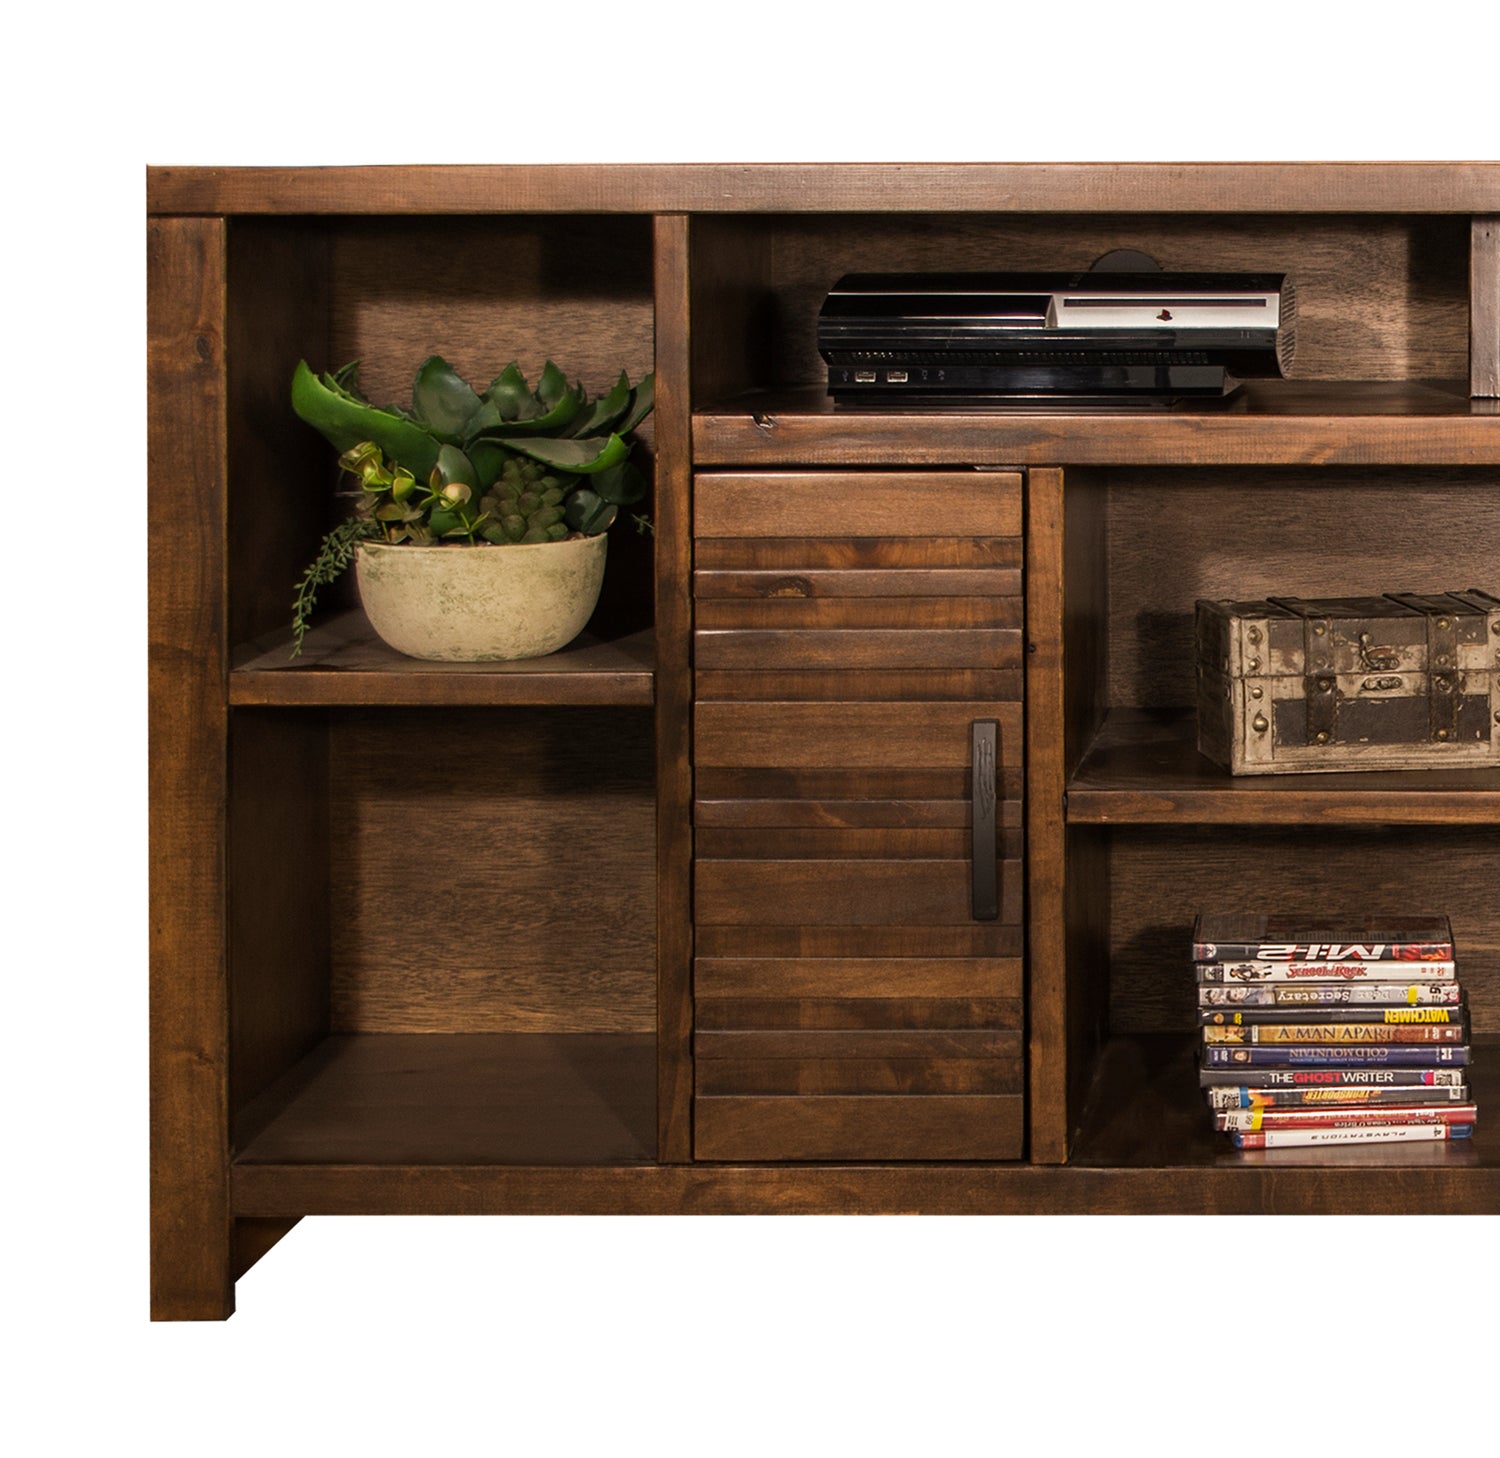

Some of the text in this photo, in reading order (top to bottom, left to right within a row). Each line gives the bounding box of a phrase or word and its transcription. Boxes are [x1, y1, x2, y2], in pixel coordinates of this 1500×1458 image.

[1279, 990, 1350, 1001] Secretary
[1384, 1009, 1449, 1023] WATCHMEN
[1278, 1027, 1393, 1039] A MAN APART
[1289, 1048, 1389, 1057] COLD MOUNTAIN
[1269, 1072, 1394, 1083] THE GHOST WRITER
[1305, 1090, 1370, 1100] TRANSPORTER
[1322, 1131, 1406, 1140] PLAYSTATION
